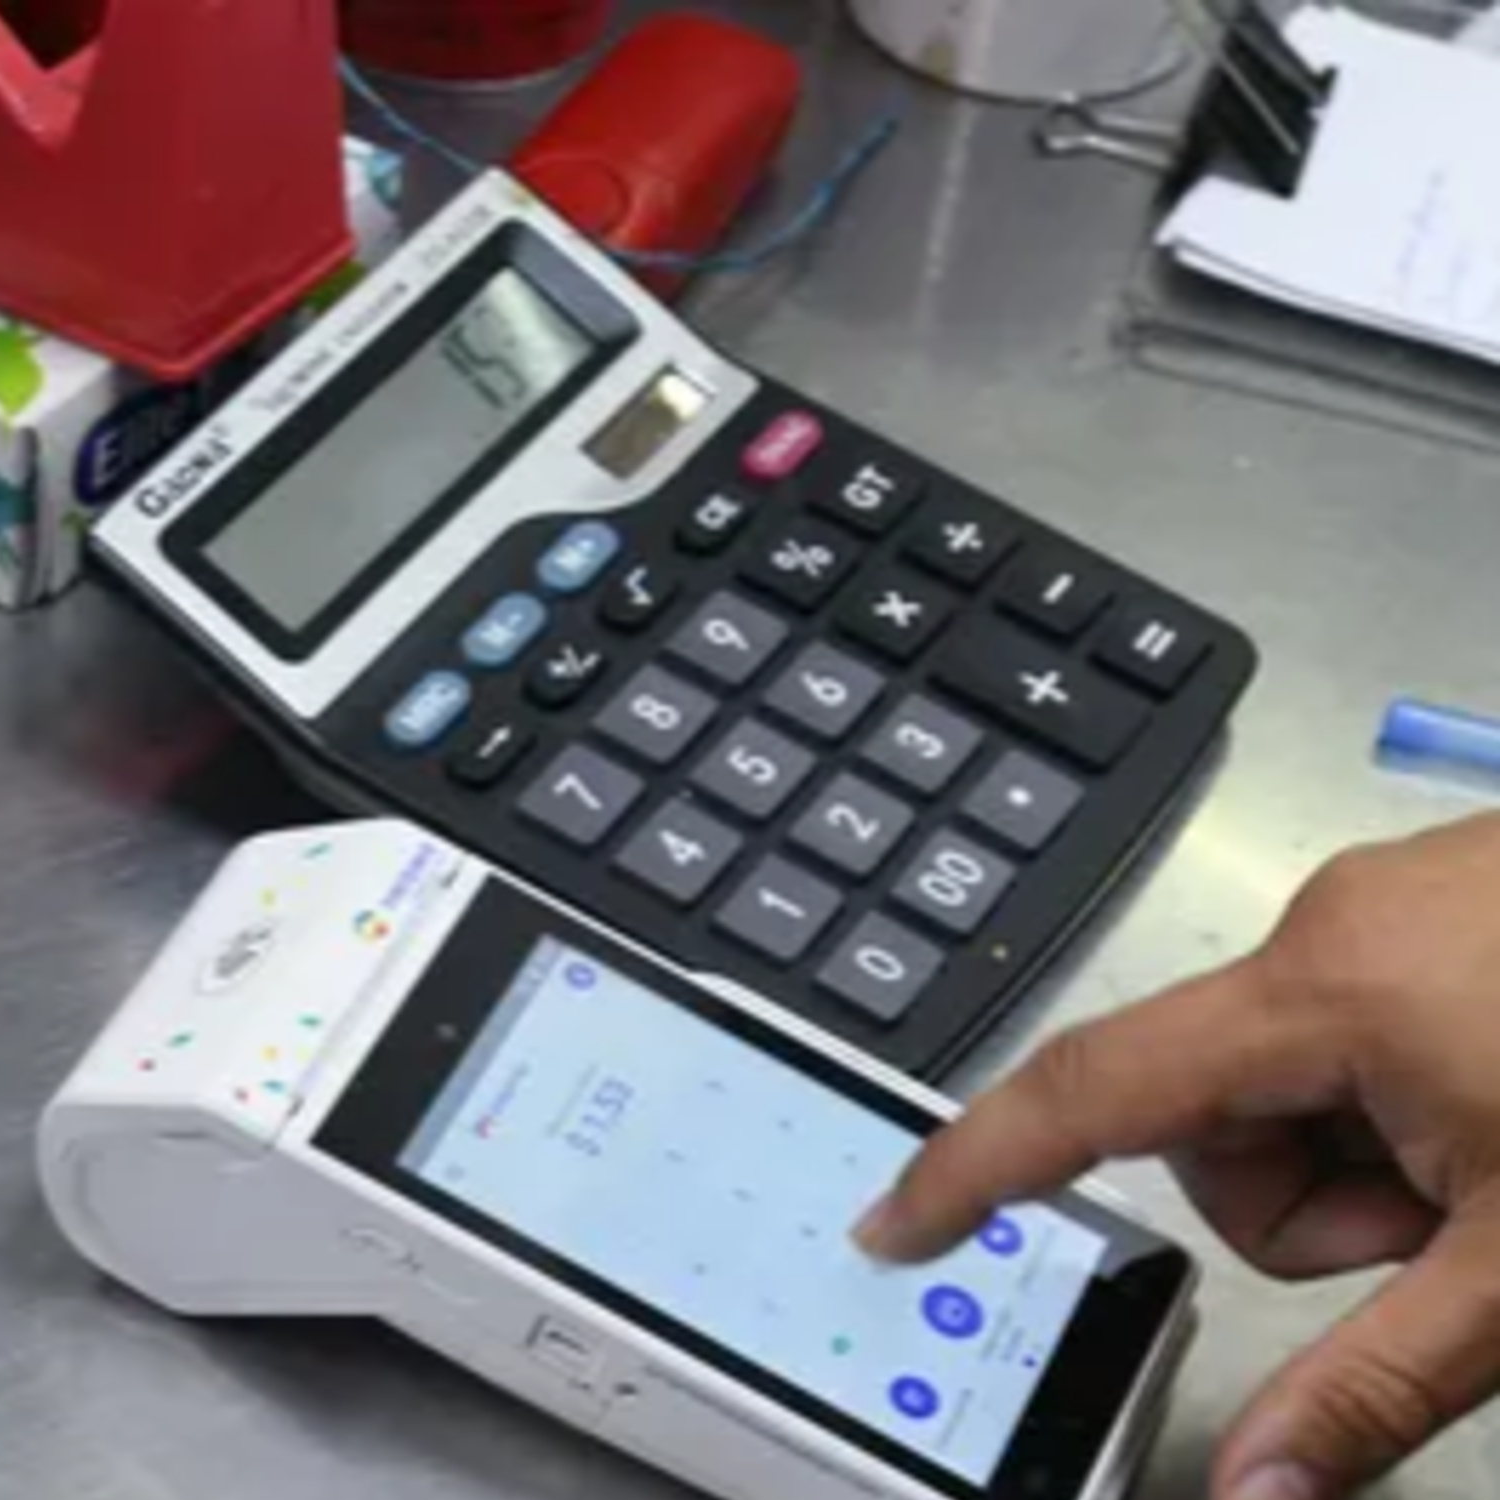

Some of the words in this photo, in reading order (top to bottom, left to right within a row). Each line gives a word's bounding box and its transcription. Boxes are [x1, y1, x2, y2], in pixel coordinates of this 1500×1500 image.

[842, 466, 895, 512] GT
[702, 616, 751, 651] 9
[799, 669, 848, 708] 6
[629, 694, 680, 730] 8
[895, 722, 946, 760] 3
[730, 747, 778, 784] 5
[554, 772, 605, 812] 7
[827, 803, 879, 841] 2
[658, 830, 705, 867] 4
[918, 850, 984, 907] 00
[758, 888, 806, 920] 1
[855, 947, 906, 981] 0
